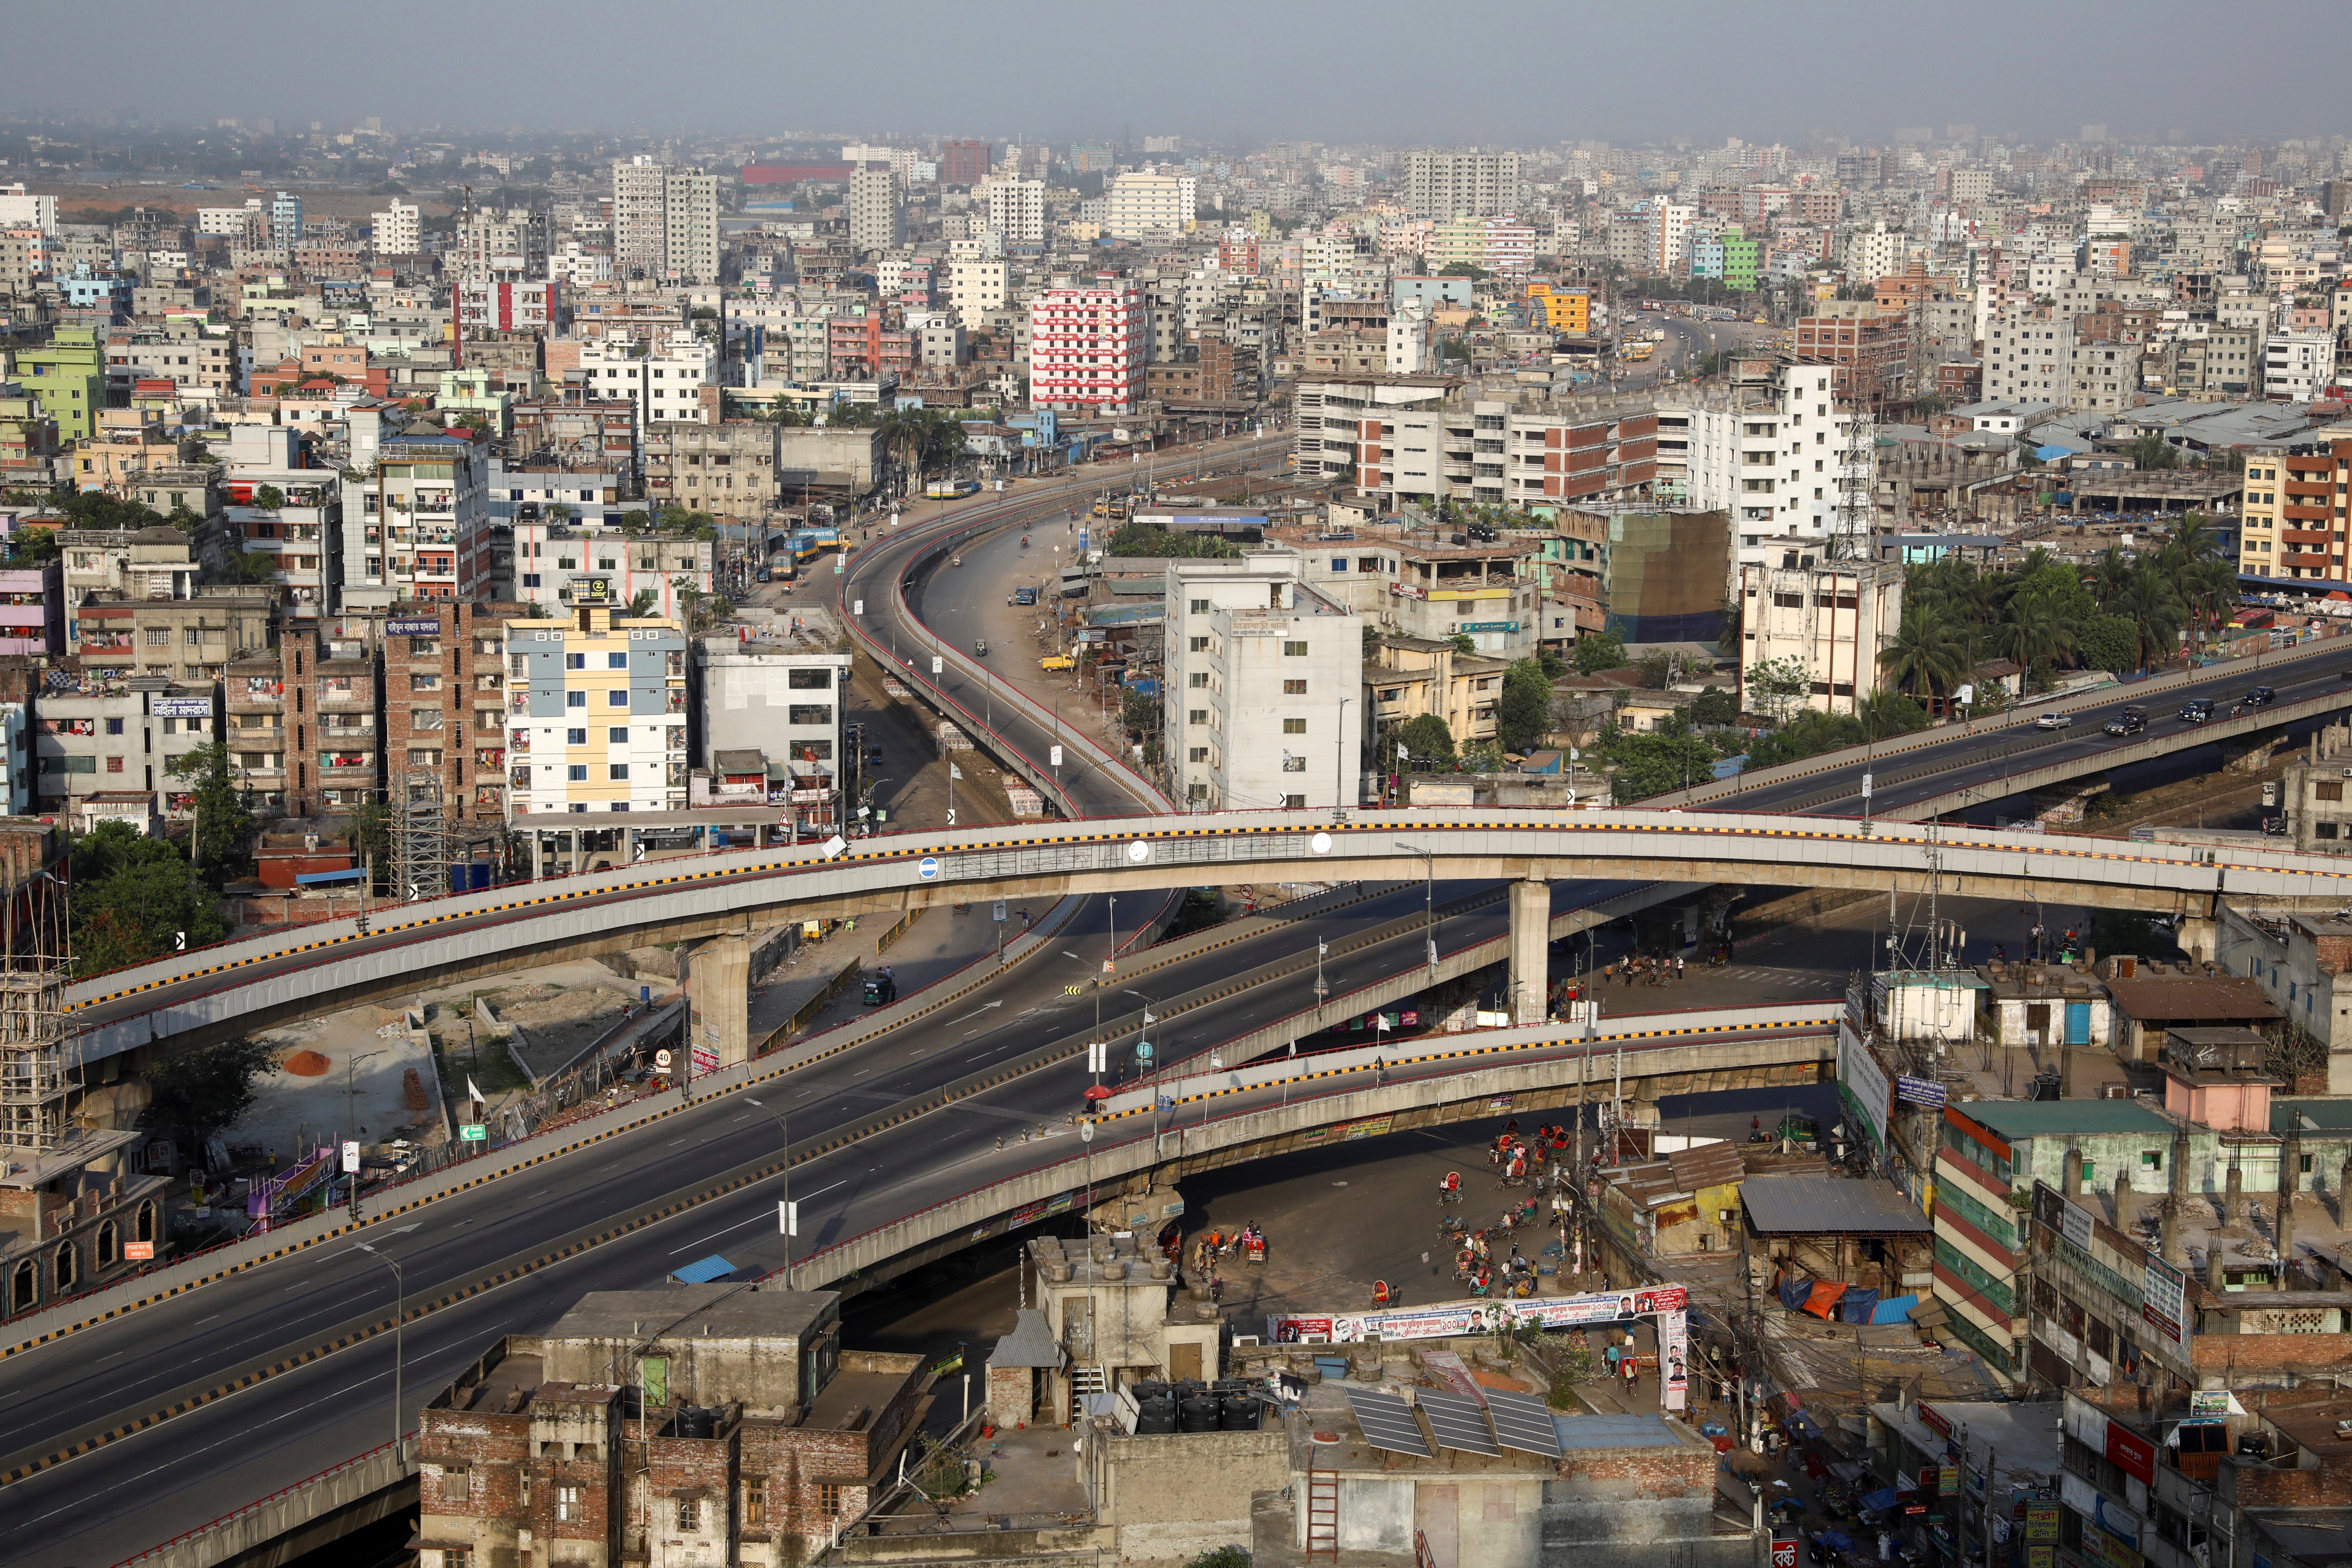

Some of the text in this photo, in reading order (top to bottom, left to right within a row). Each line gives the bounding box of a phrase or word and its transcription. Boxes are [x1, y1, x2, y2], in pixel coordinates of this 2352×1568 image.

[387, 622, 438, 634] বাইতুন নাজাত মাদরাসা
[1233, 621, 1268, 630] যাত্রাবাড়ী
[154, 704, 208, 716] মহিলা মাদরাসা
[1053, 1194, 1072, 1204] Scholars
[1549, 1306, 1567, 1314] মুজিবুর
[1385, 1322, 1398, 1330] বঙ্গবন্ধু
[1408, 1319, 1422, 1328] মুজিবুর
[1443, 1321, 1456, 1330] ১০০
[2030, 1511, 2057, 1520] পল্লী
[2029, 1520, 2058, 1529] চিকিৎসক
[2032, 1529, 2050, 1537] ট্রেনিং
[2031, 1549, 2050, 1560] চাঁদপুর
[2101, 1536, 2109, 1554] পল্লী
[2111, 1540, 2129, 1564] চিকিৎসক
